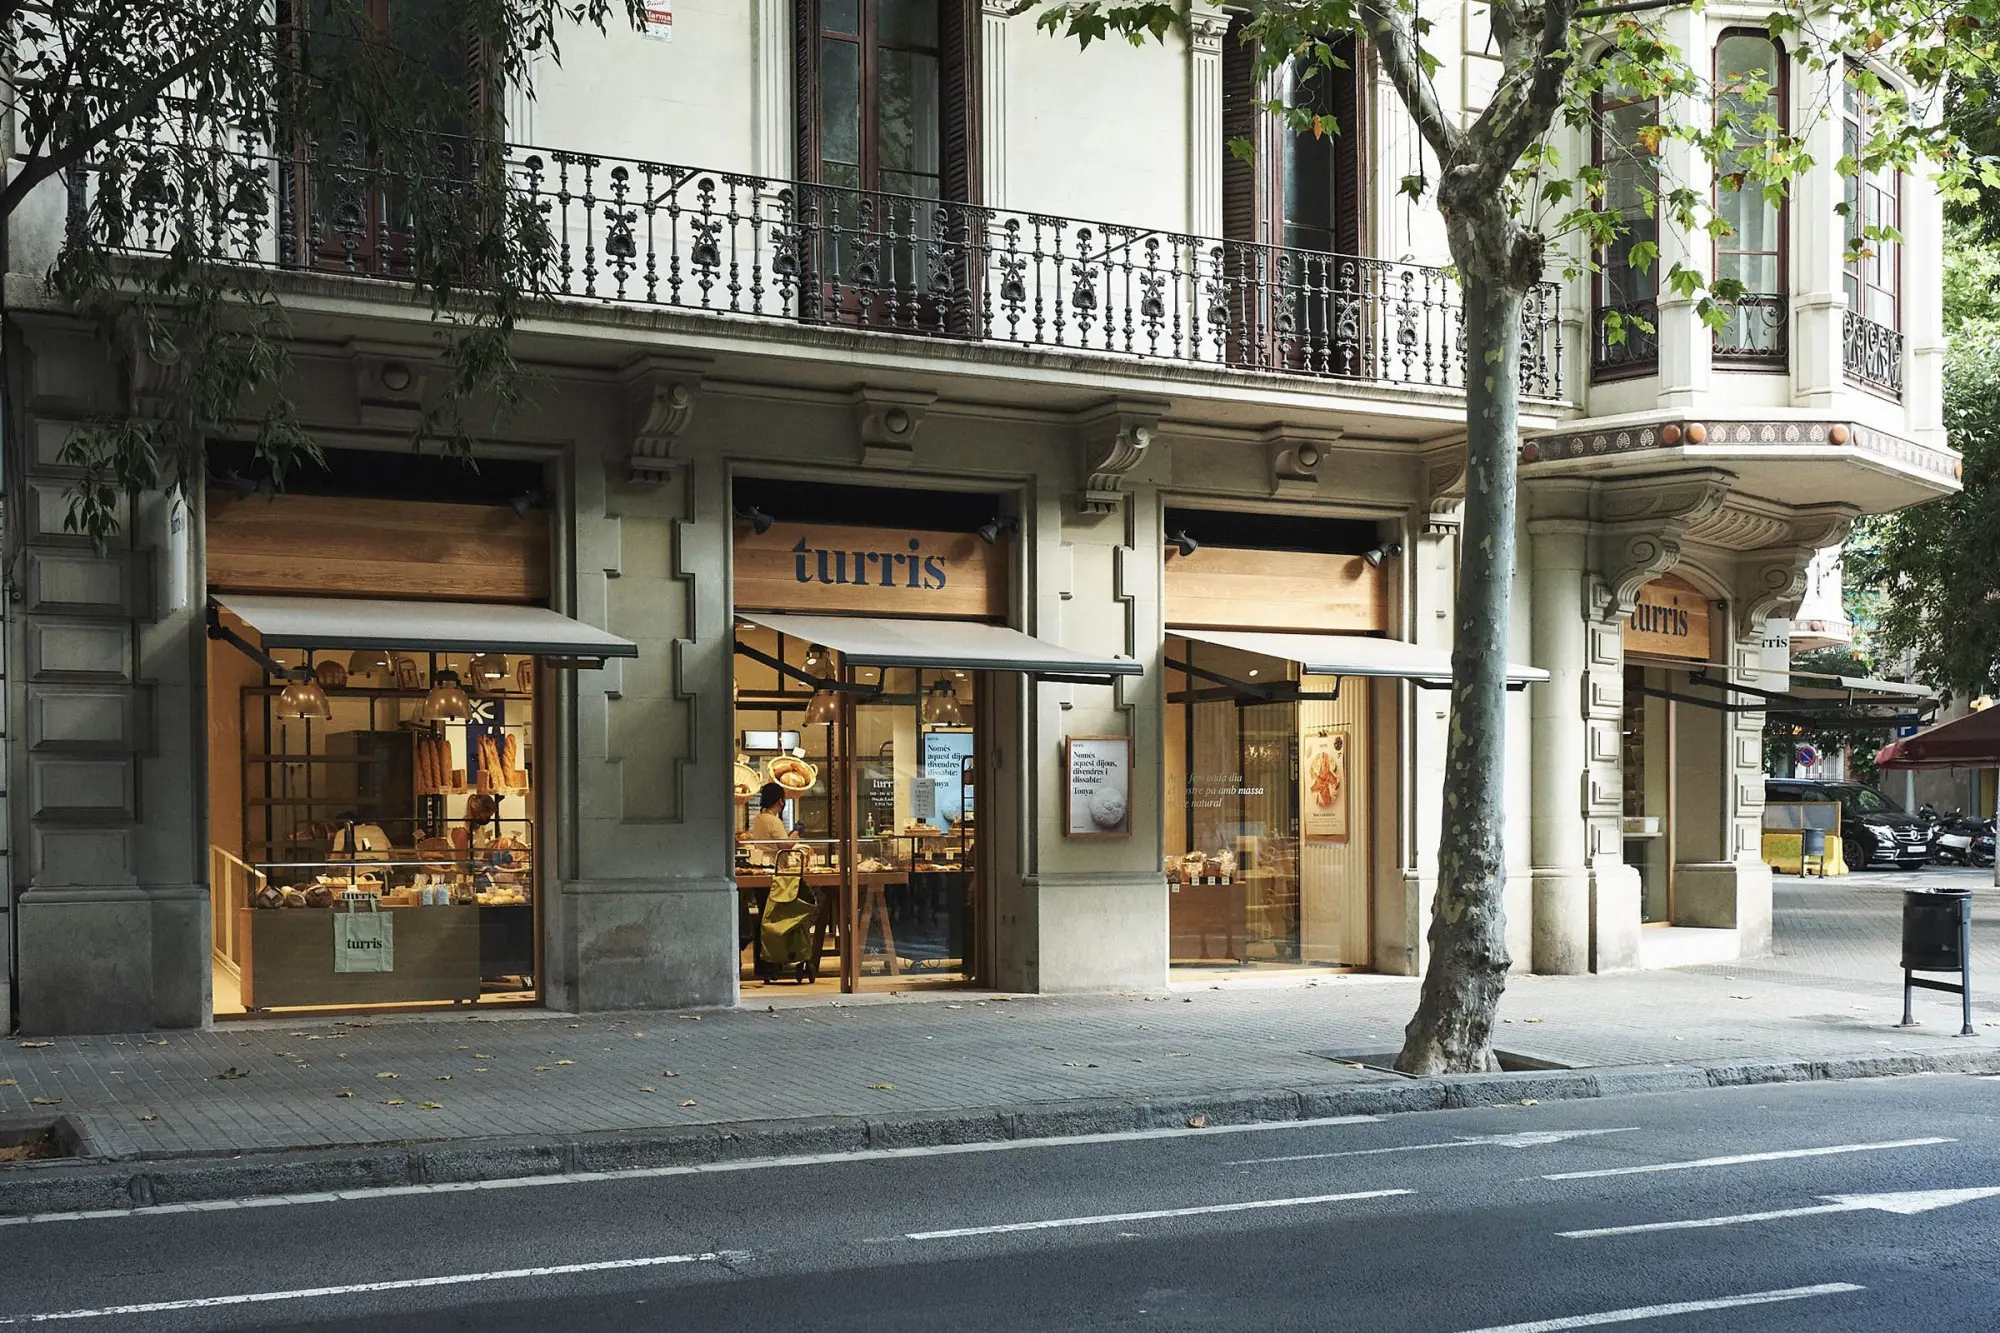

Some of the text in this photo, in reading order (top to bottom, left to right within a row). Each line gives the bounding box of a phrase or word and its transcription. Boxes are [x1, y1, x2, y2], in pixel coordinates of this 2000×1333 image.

[792, 537, 947, 590] turris
[1630, 595, 1688, 637] turris
[1761, 635, 1788, 648] rris
[928, 744, 951, 752] Només
[928, 753, 950, 761] aquest
[1073, 751, 1096, 759] Només
[1073, 759, 1118, 768] aquest dijous,
[1073, 767, 1104, 775] divendres
[1072, 775, 1102, 784] dissabte:
[1228, 773, 1243, 782] dia
[873, 780, 899, 788] turr
[935, 781, 949, 789] onya
[1073, 787, 1094, 796] Tonya
[1218, 785, 1237, 795] amb
[1238, 787, 1264, 795] massa
[1191, 798, 1222, 808] natural
[346, 938, 383, 949] turris
